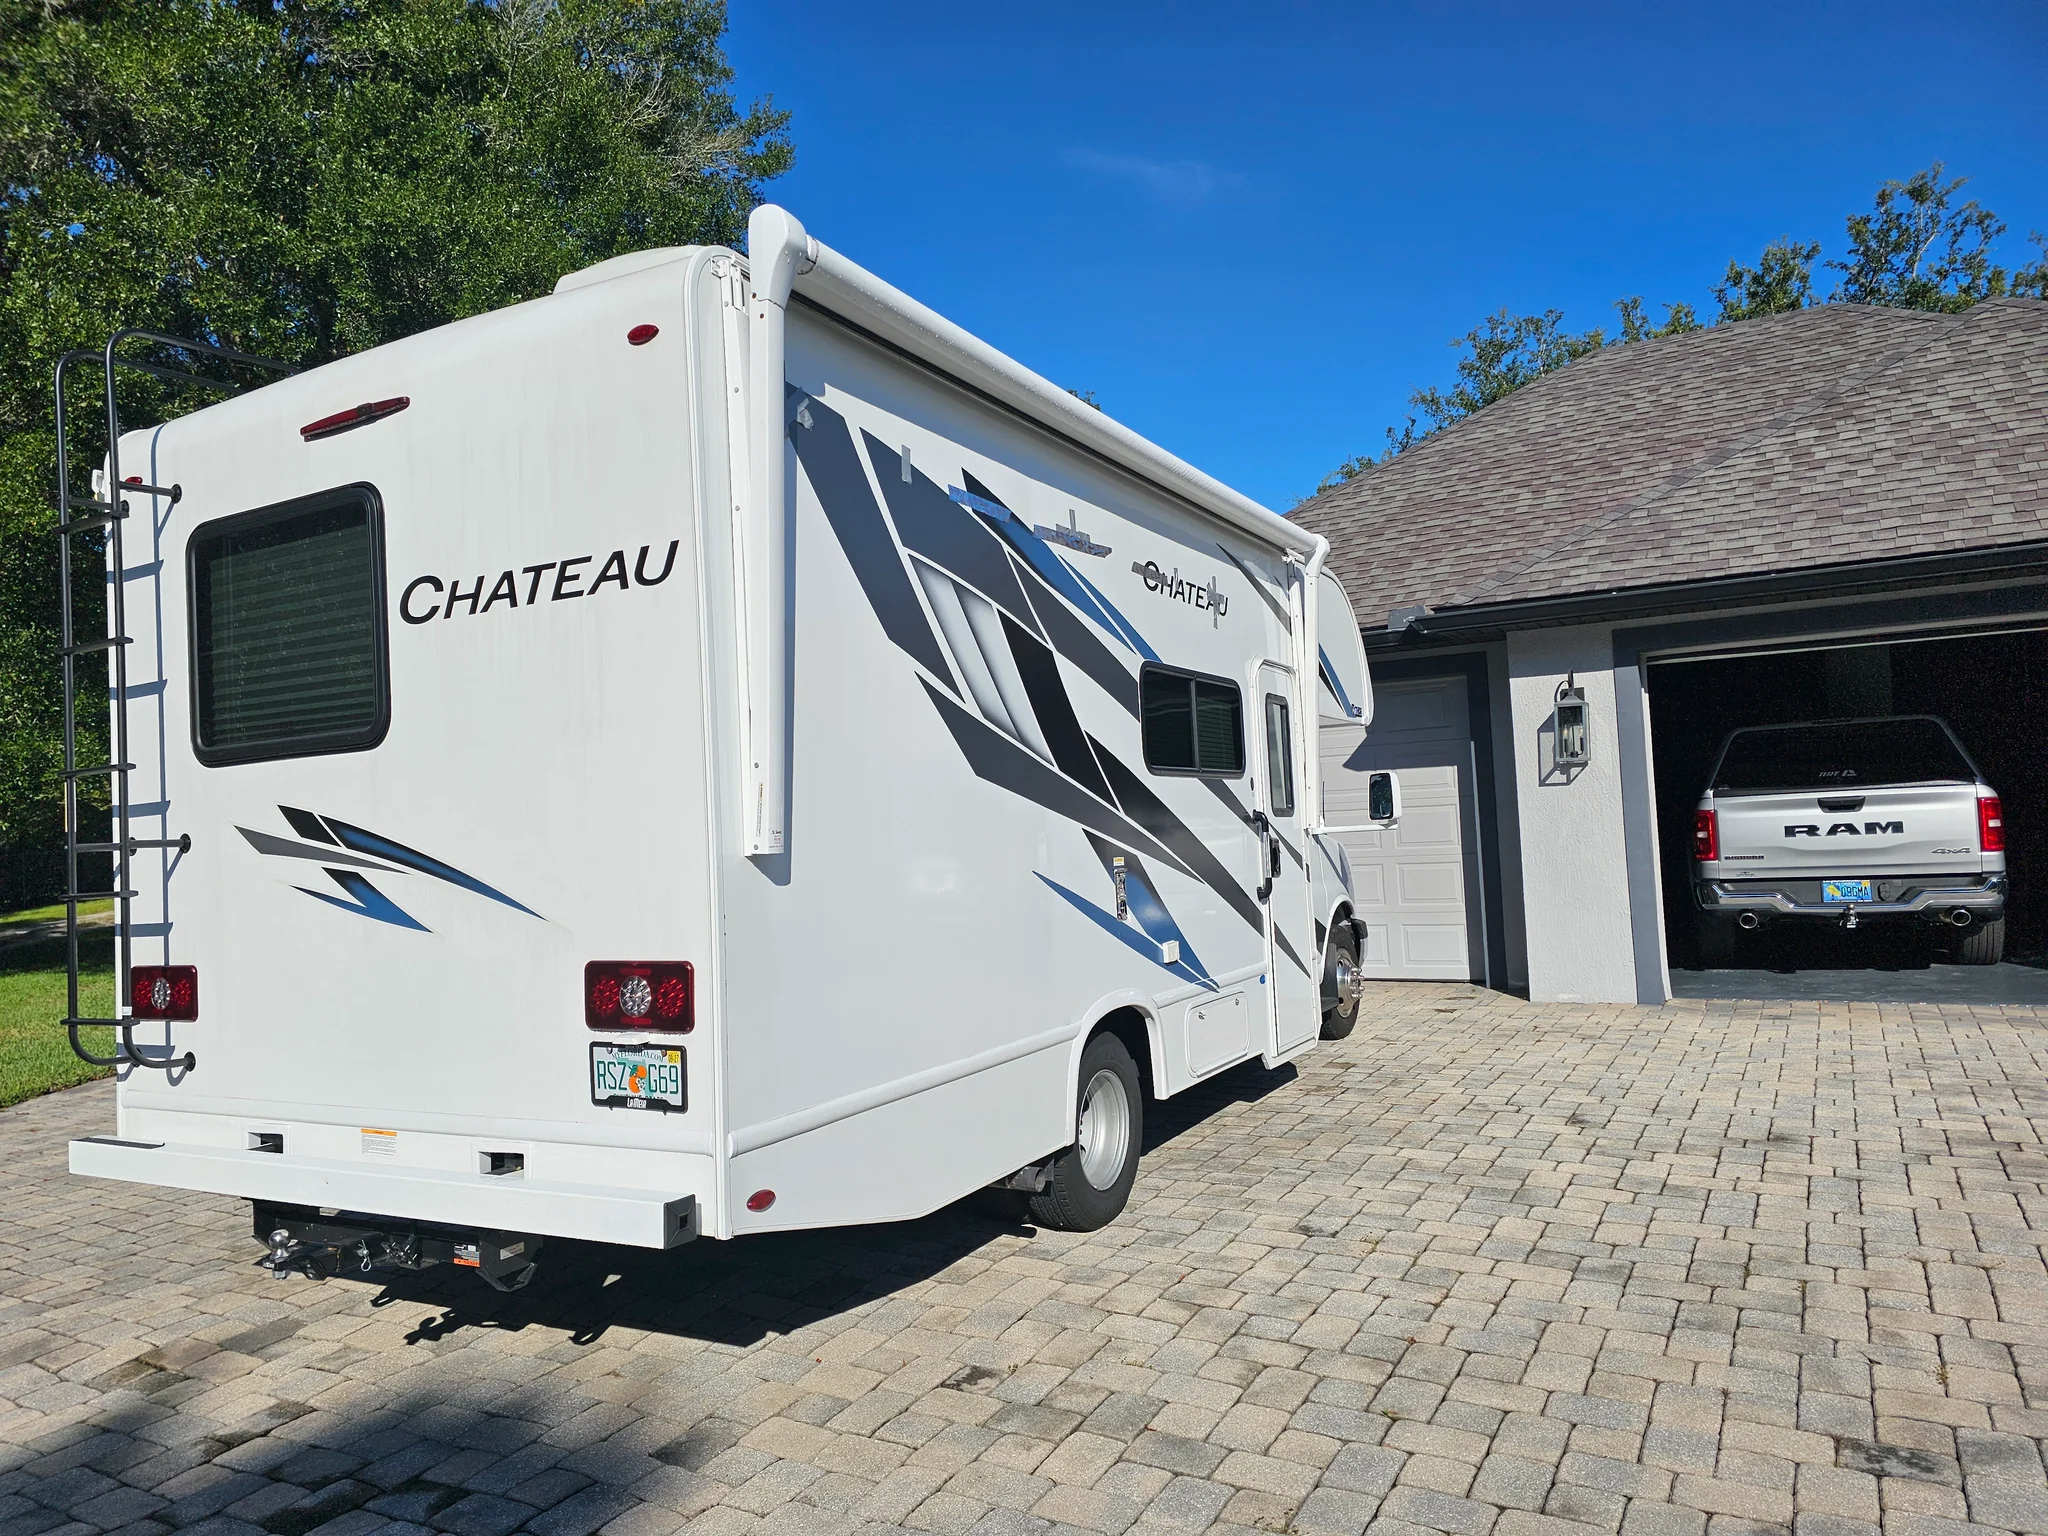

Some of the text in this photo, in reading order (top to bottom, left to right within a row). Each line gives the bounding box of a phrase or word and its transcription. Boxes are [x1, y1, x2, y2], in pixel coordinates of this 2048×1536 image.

[399, 539, 679, 625] CHATEAU
[1784, 821, 1904, 838] RAM
[596, 1060, 679, 1095] RSZ G69
